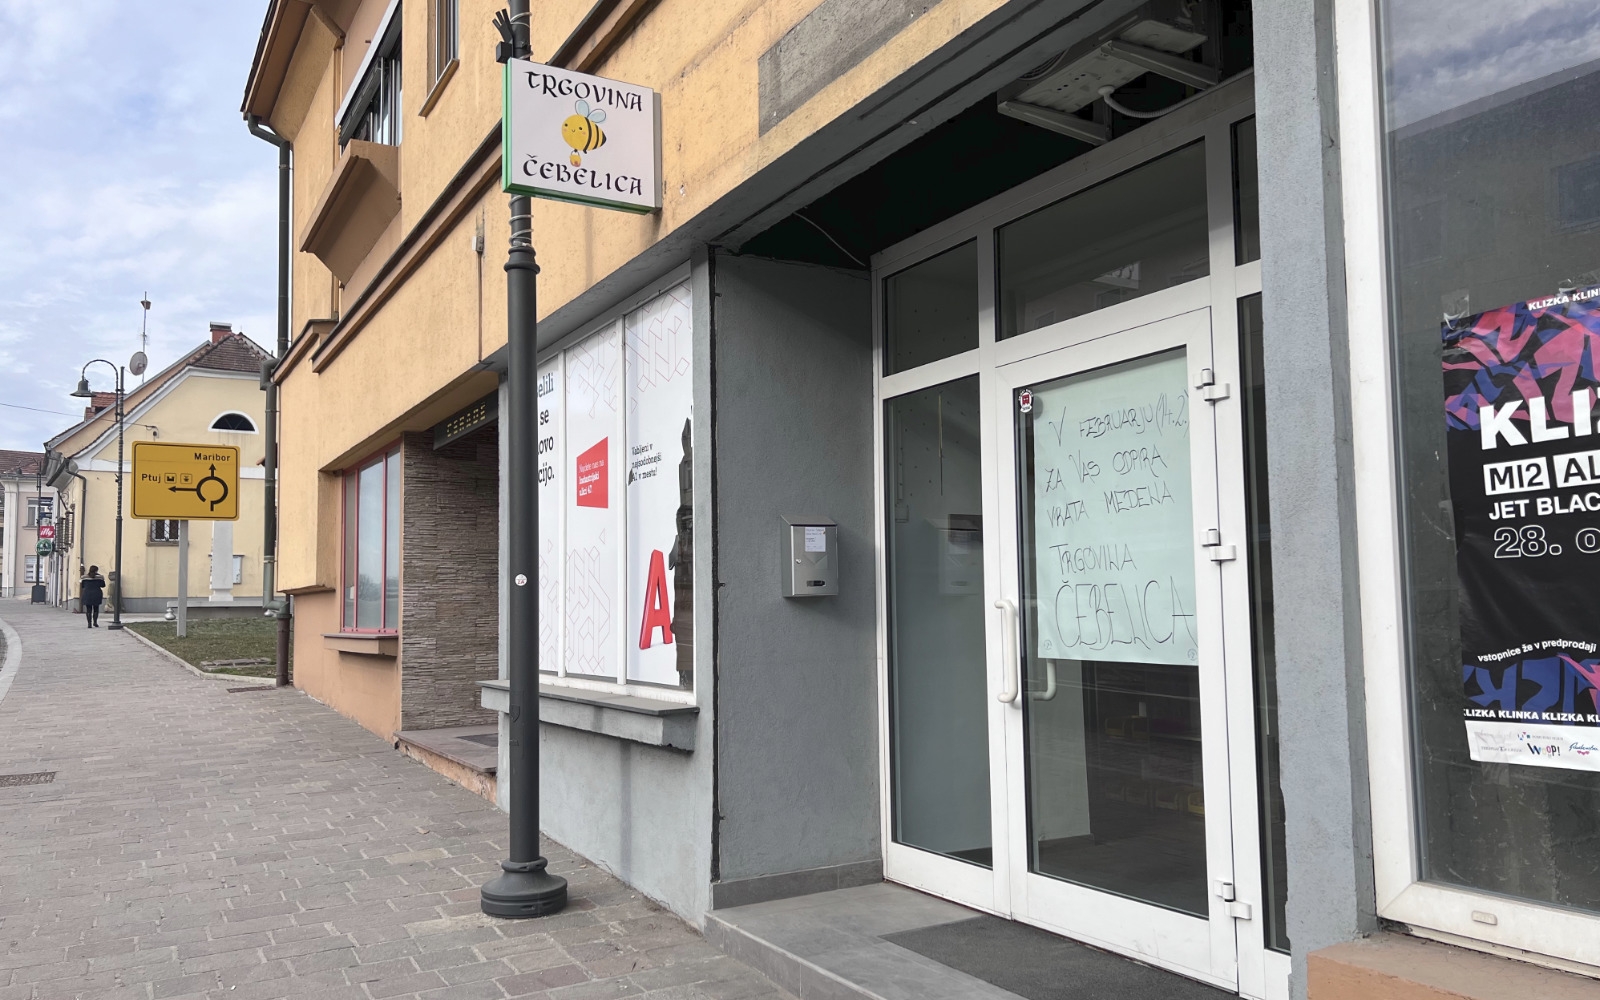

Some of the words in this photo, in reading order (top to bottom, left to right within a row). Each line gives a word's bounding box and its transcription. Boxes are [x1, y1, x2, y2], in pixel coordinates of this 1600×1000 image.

[523, 71, 642, 112] TRGOVINA
[522, 153, 642, 196] ČEBELICA
[1528, 295, 1570, 311] KLIZKA
[1572, 287, 1600, 301] KLIN
[540, 409, 550, 425] se
[1048, 405, 1067, 447] V
[1079, 402, 1154, 438] FEBRUARJU
[1480, 387, 1600, 450] KLI
[194, 452, 231, 462] Maribor
[1044, 467, 1066, 492] ZA
[1068, 449, 1101, 484] VAS
[141, 473, 161, 483] Ptuj
[1489, 462, 1544, 491] MI2
[1046, 499, 1090, 528] VRATA
[1103, 480, 1175, 514] MEDENA
[1488, 498, 1530, 520] JET
[1494, 524, 1563, 558] 28.
[1049, 543, 1138, 575] TRGOVINA
[1055, 575, 1199, 651] ČEBELICA
[1477, 647, 1521, 662] vstopnice
[1522, 643, 1534, 653] že
[1534, 641, 1540, 650] v
[1541, 638, 1597, 654] predprodaji
[1498, 709, 1540, 720] KLINKA
[1541, 711, 1585, 722] KLIZKA
